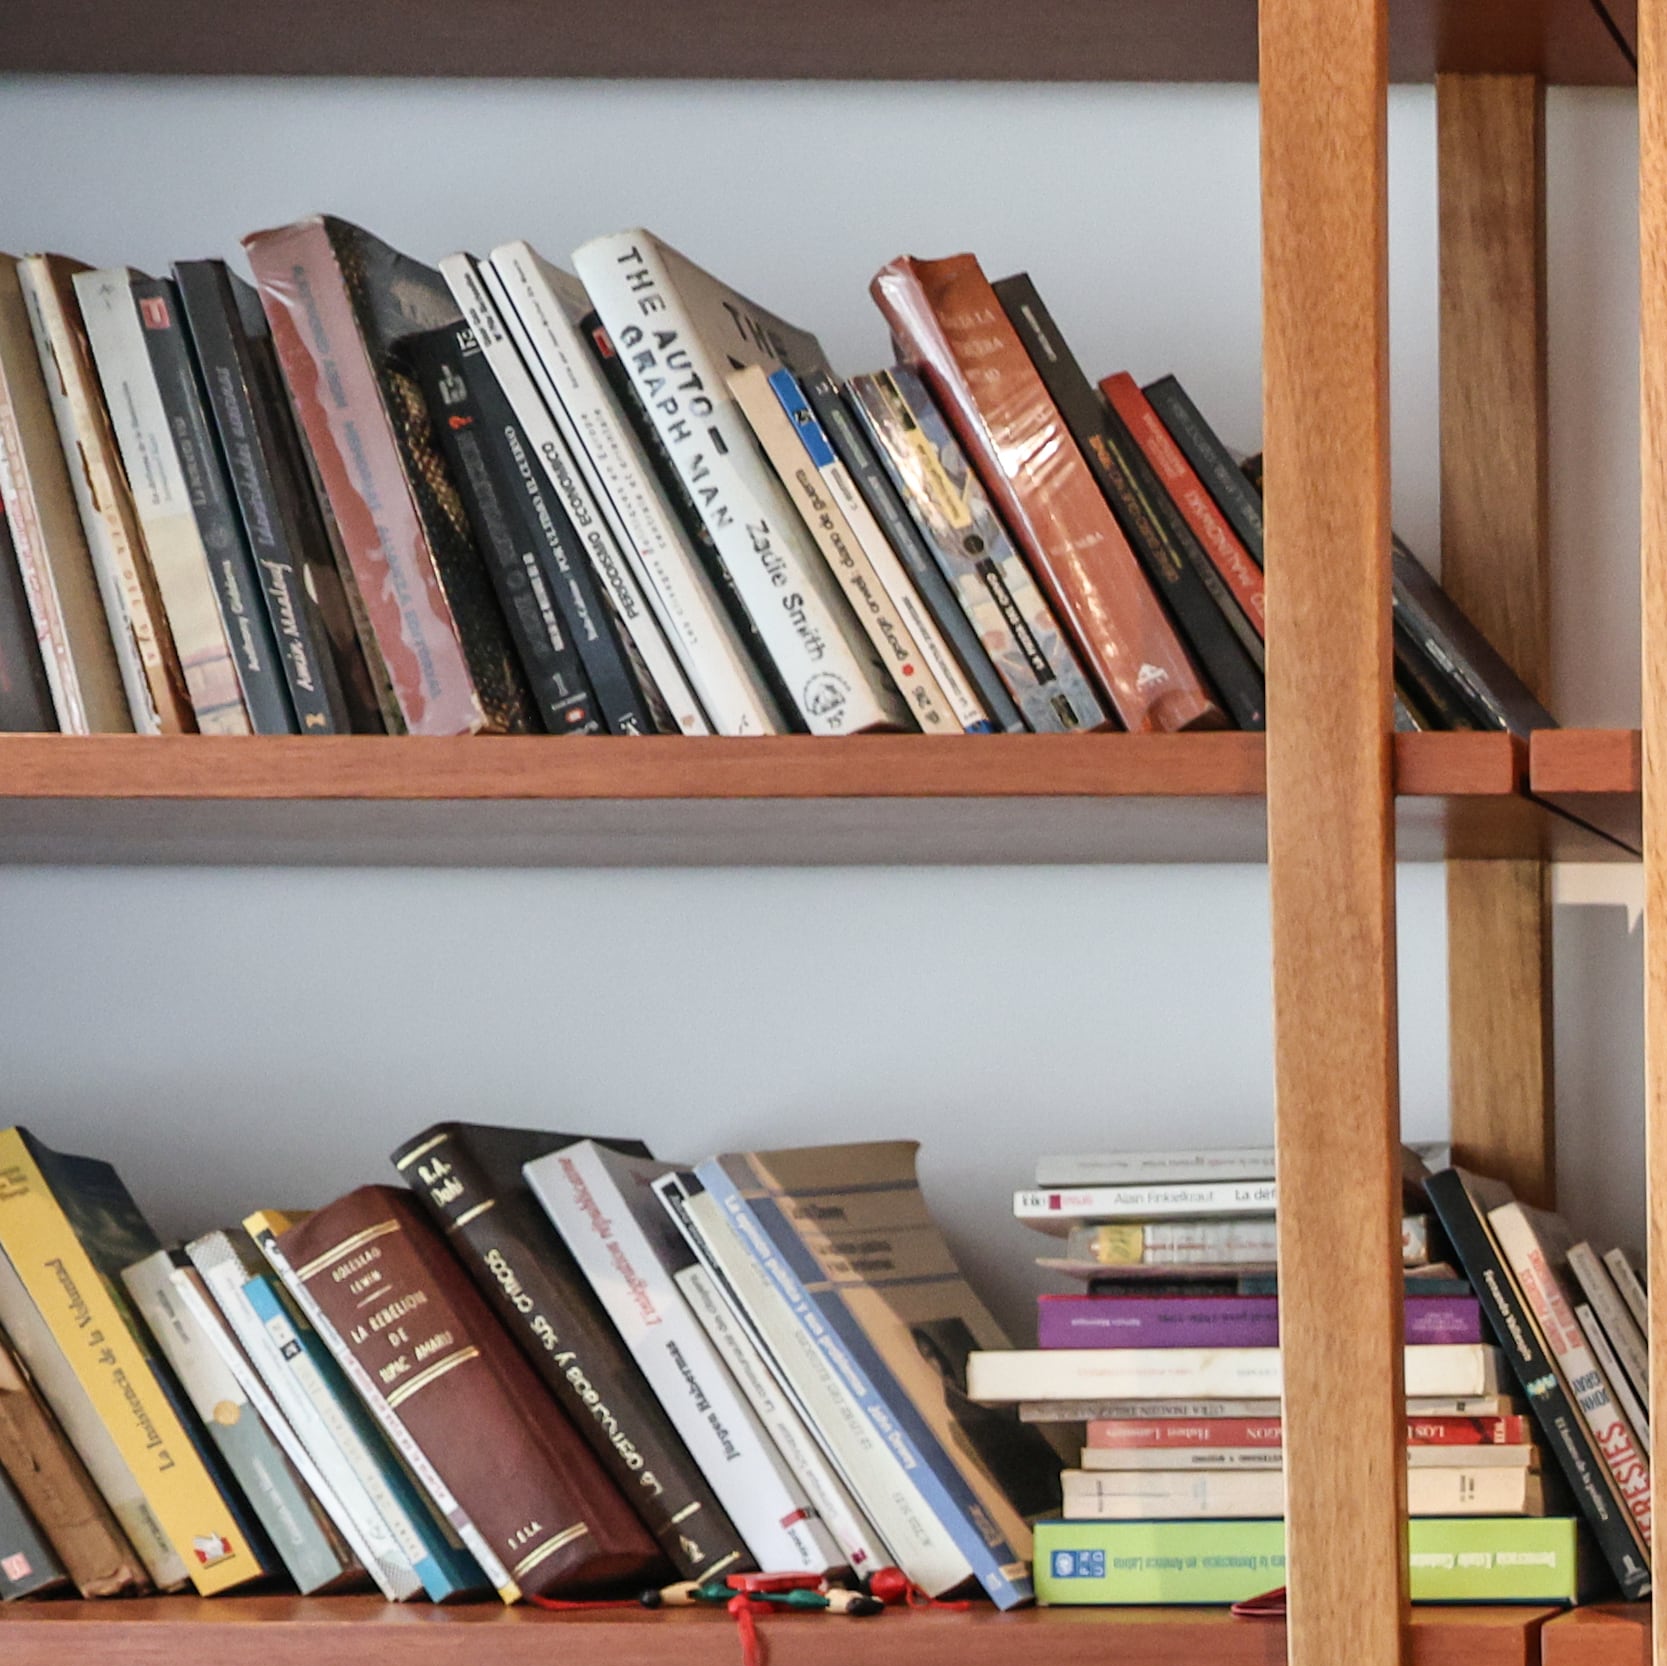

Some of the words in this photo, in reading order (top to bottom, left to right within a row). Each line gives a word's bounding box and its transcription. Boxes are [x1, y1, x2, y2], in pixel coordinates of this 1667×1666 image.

[613, 245, 665, 318] THE
[651, 323, 734, 459] AUTO-
[616, 321, 696, 444] GRAPH
[680, 451, 737, 530] MAN
[742, 517, 794, 589] Zadie
[778, 588, 832, 663] Smith
[44, 1255, 95, 1328] Voluntad
[723, 1195, 740, 1214] La
[793, 1301, 808, 1315] y
[817, 1332, 868, 1398] problemas
[85, 1328, 105, 1347] la
[95, 1346, 117, 1369] de
[106, 1367, 163, 1451] Insistencia
[663, 1339, 710, 1414] Habermas
[1571, 1369, 1602, 1395] GRAY
[1581, 1389, 1612, 1413] JOHN
[152, 1448, 174, 1472] La
[703, 1410, 740, 1462] Jürgen
[864, 1402, 893, 1434] John
[883, 1429, 919, 1472] Dewey
